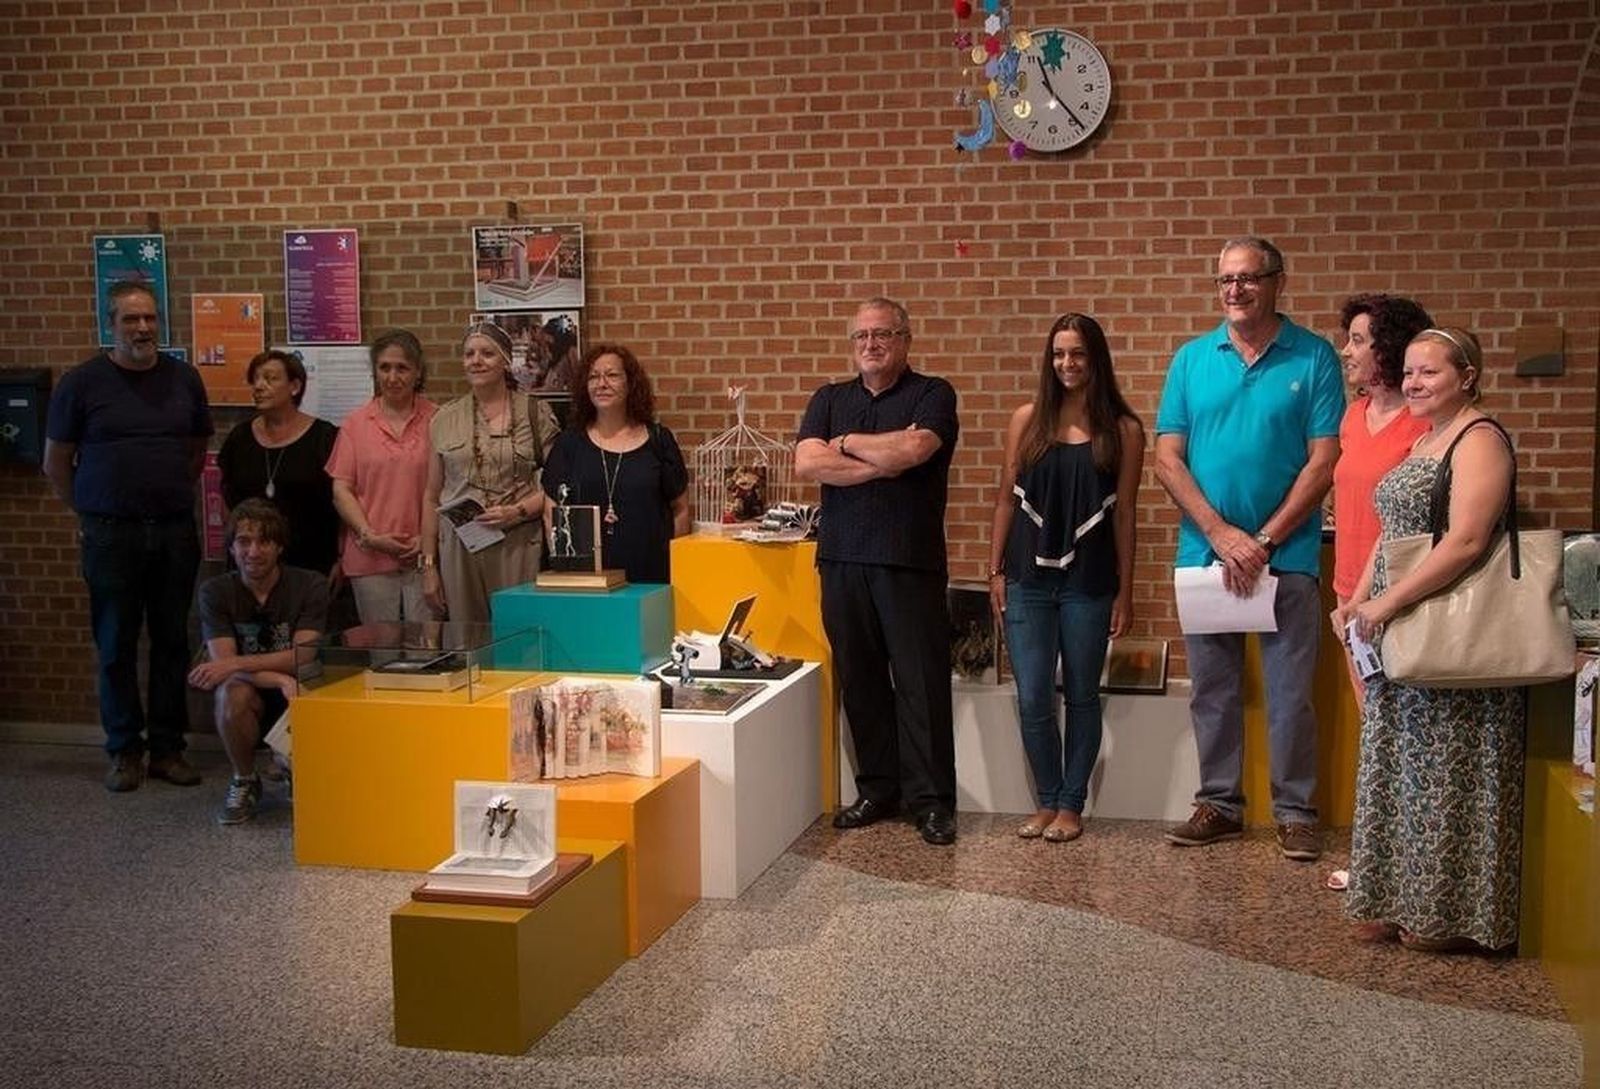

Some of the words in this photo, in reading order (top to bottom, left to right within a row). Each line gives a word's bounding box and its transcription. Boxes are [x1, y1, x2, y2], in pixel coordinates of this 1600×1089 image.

[1077, 64, 1087, 74] 2
[1084, 83, 1094, 93] 3
[1009, 89, 1019, 99] 9
[1080, 101, 1089, 111] 4
[1029, 120, 1038, 130] 7
[1068, 117, 1078, 127] 5
[1048, 124, 1058, 134] 6
